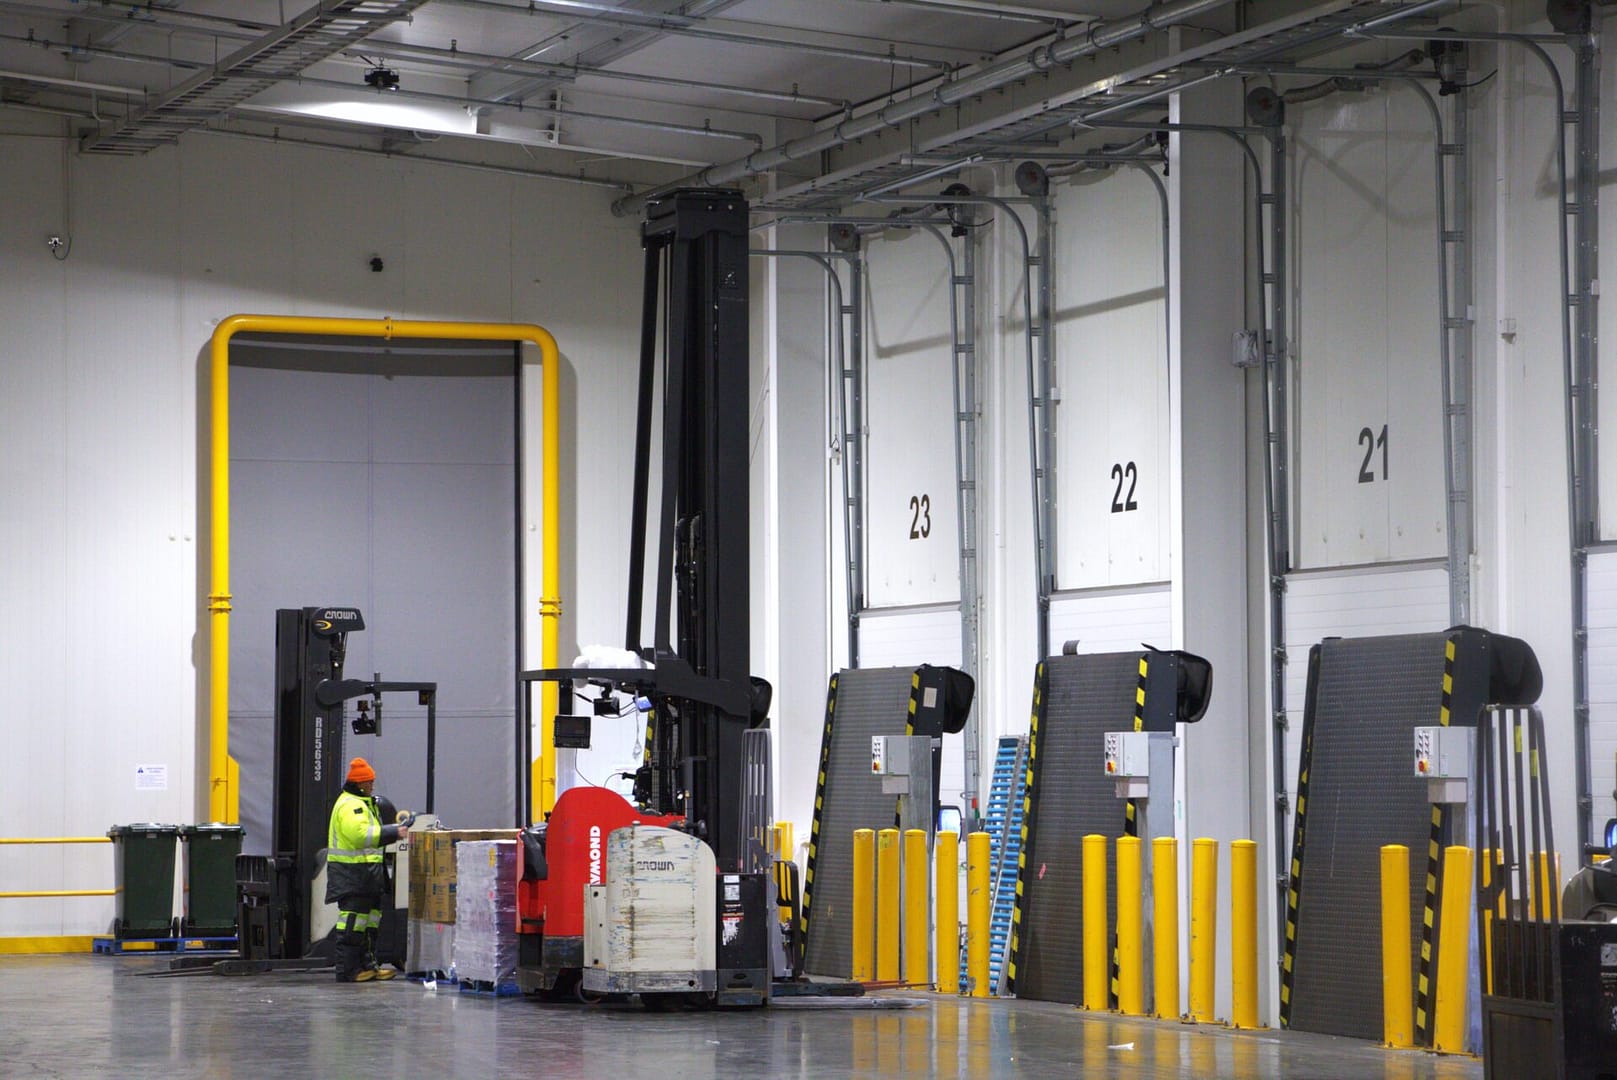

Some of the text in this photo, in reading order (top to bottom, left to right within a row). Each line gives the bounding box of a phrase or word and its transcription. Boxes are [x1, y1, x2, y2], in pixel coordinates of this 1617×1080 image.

[1358, 424, 1388, 484] 21
[1111, 461, 1137, 513] 22
[910, 494, 931, 540] 23
[324, 610, 358, 620] CROWN
[589, 826, 601, 885] YMOND
